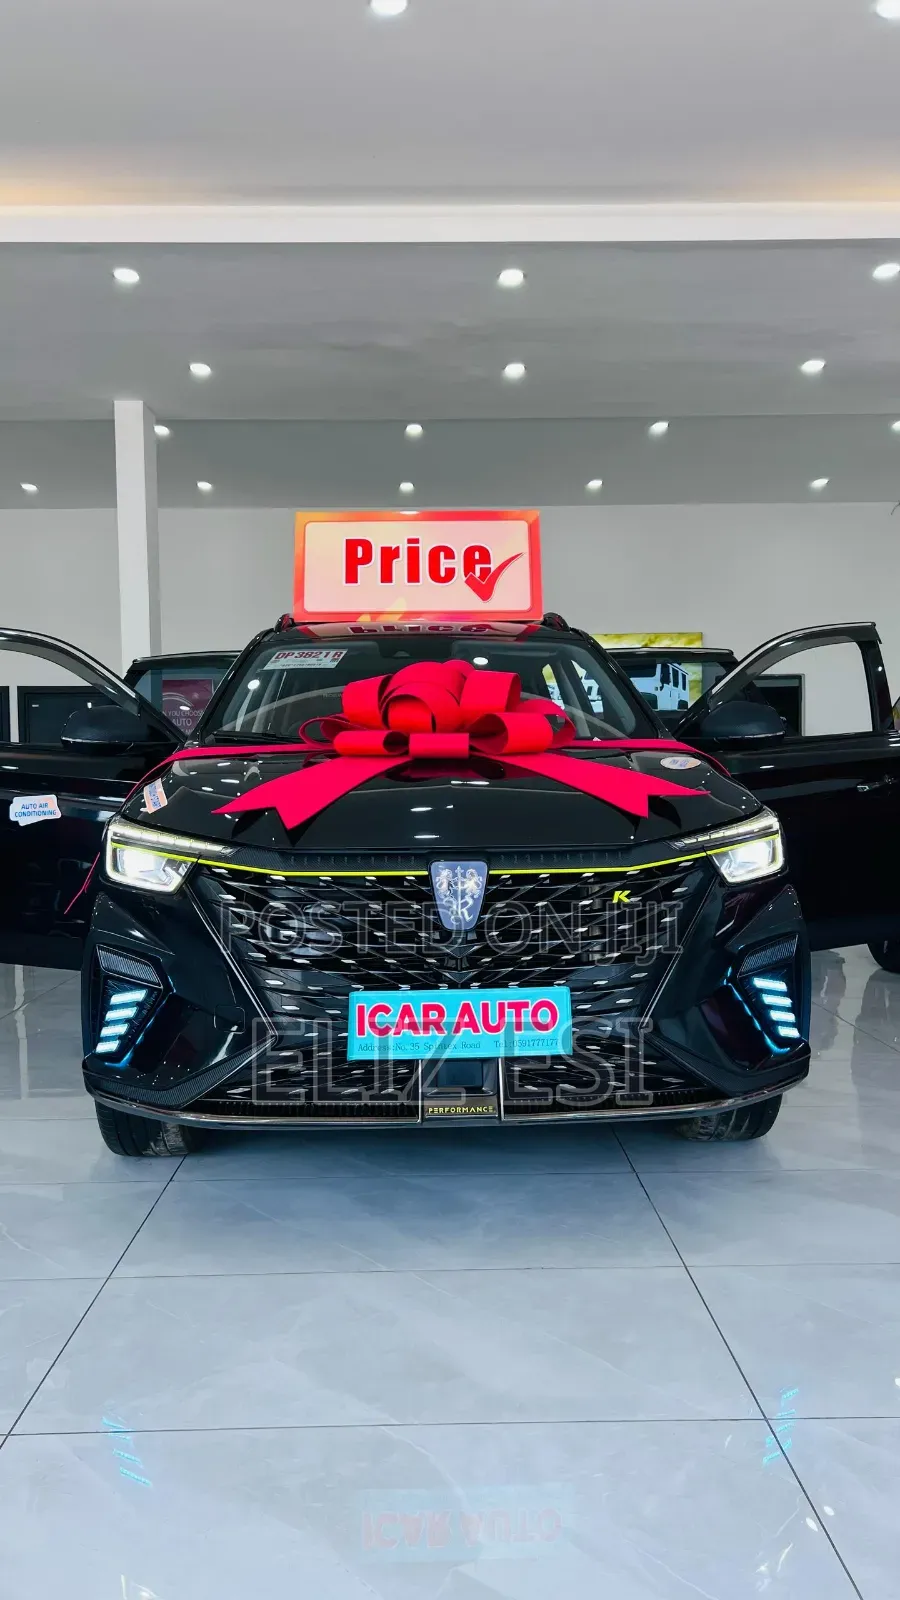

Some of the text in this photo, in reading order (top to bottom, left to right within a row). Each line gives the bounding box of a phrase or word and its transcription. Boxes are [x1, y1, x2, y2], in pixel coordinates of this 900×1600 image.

[344, 537, 493, 585] Price
[275, 651, 343, 660] DP 3821 R
[15, 810, 57, 818] CONDITIONING
[612, 890, 631, 903] K
[356, 999, 559, 1037] ICAR AUTO
[461, 1041, 481, 1049] Road
[428, 1105, 494, 1114] PERFORMANCE
